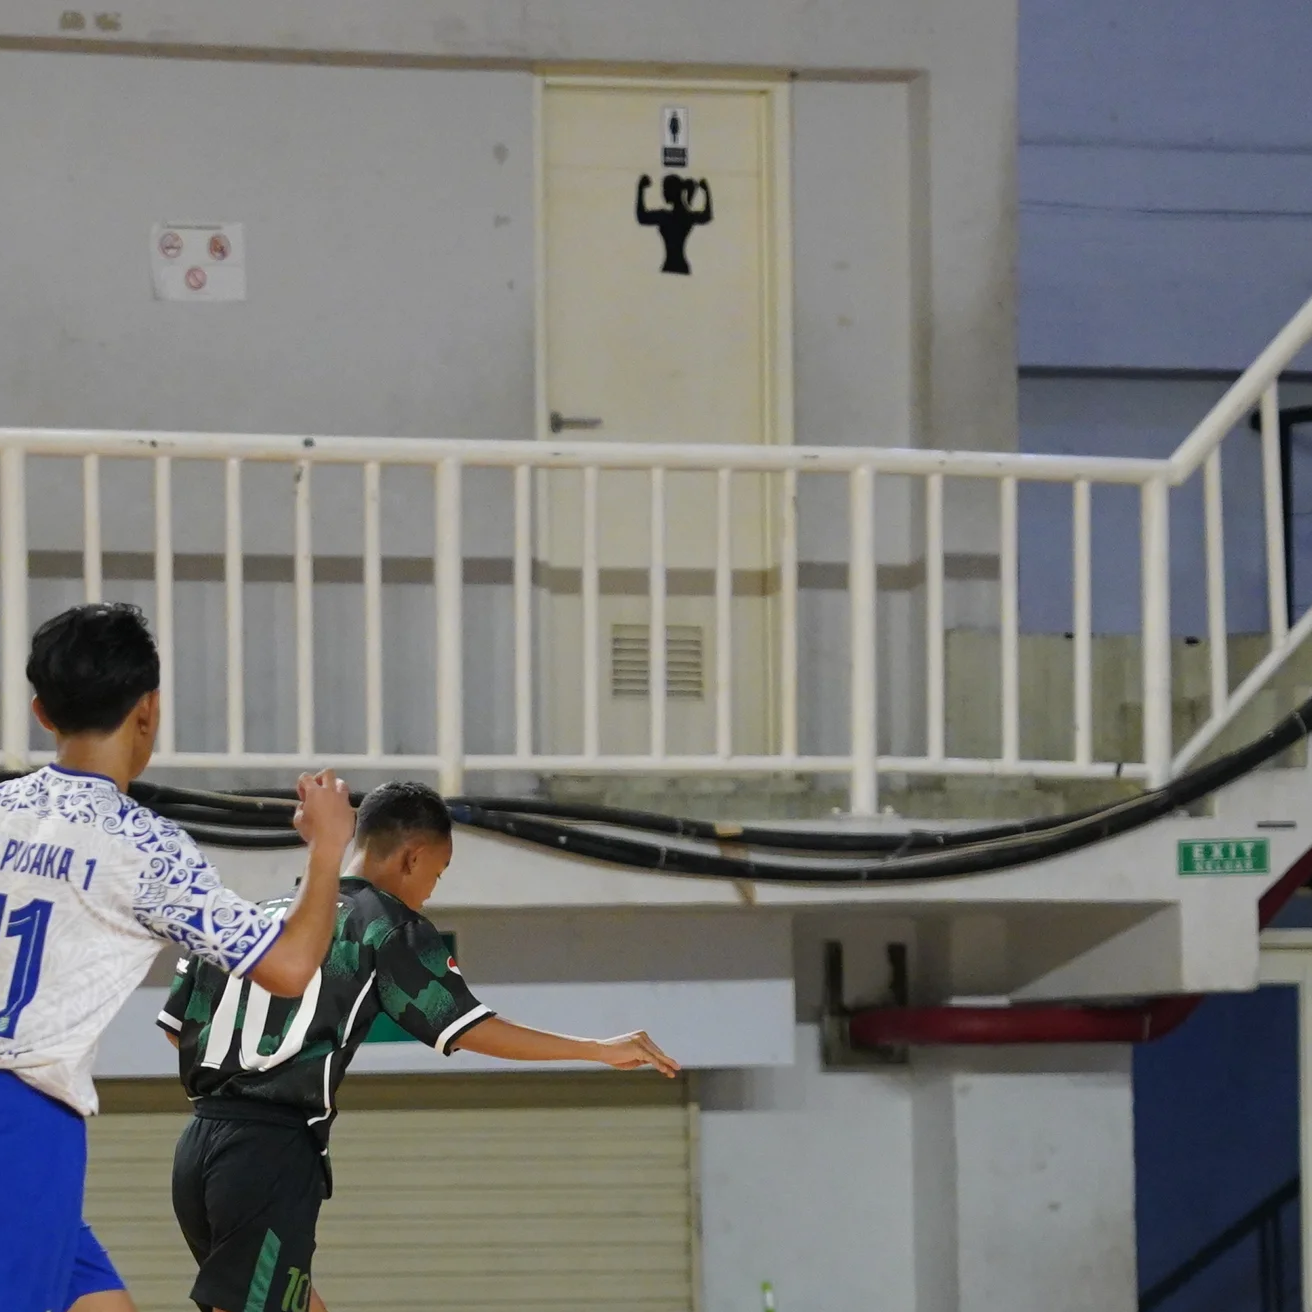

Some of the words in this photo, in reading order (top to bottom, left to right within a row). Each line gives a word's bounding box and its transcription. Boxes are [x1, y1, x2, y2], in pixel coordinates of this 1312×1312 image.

[0, 838, 75, 882] PUSAKA
[83, 858, 97, 891] 1
[1192, 842, 1255, 859] EXIT
[201, 966, 323, 1073] 10
